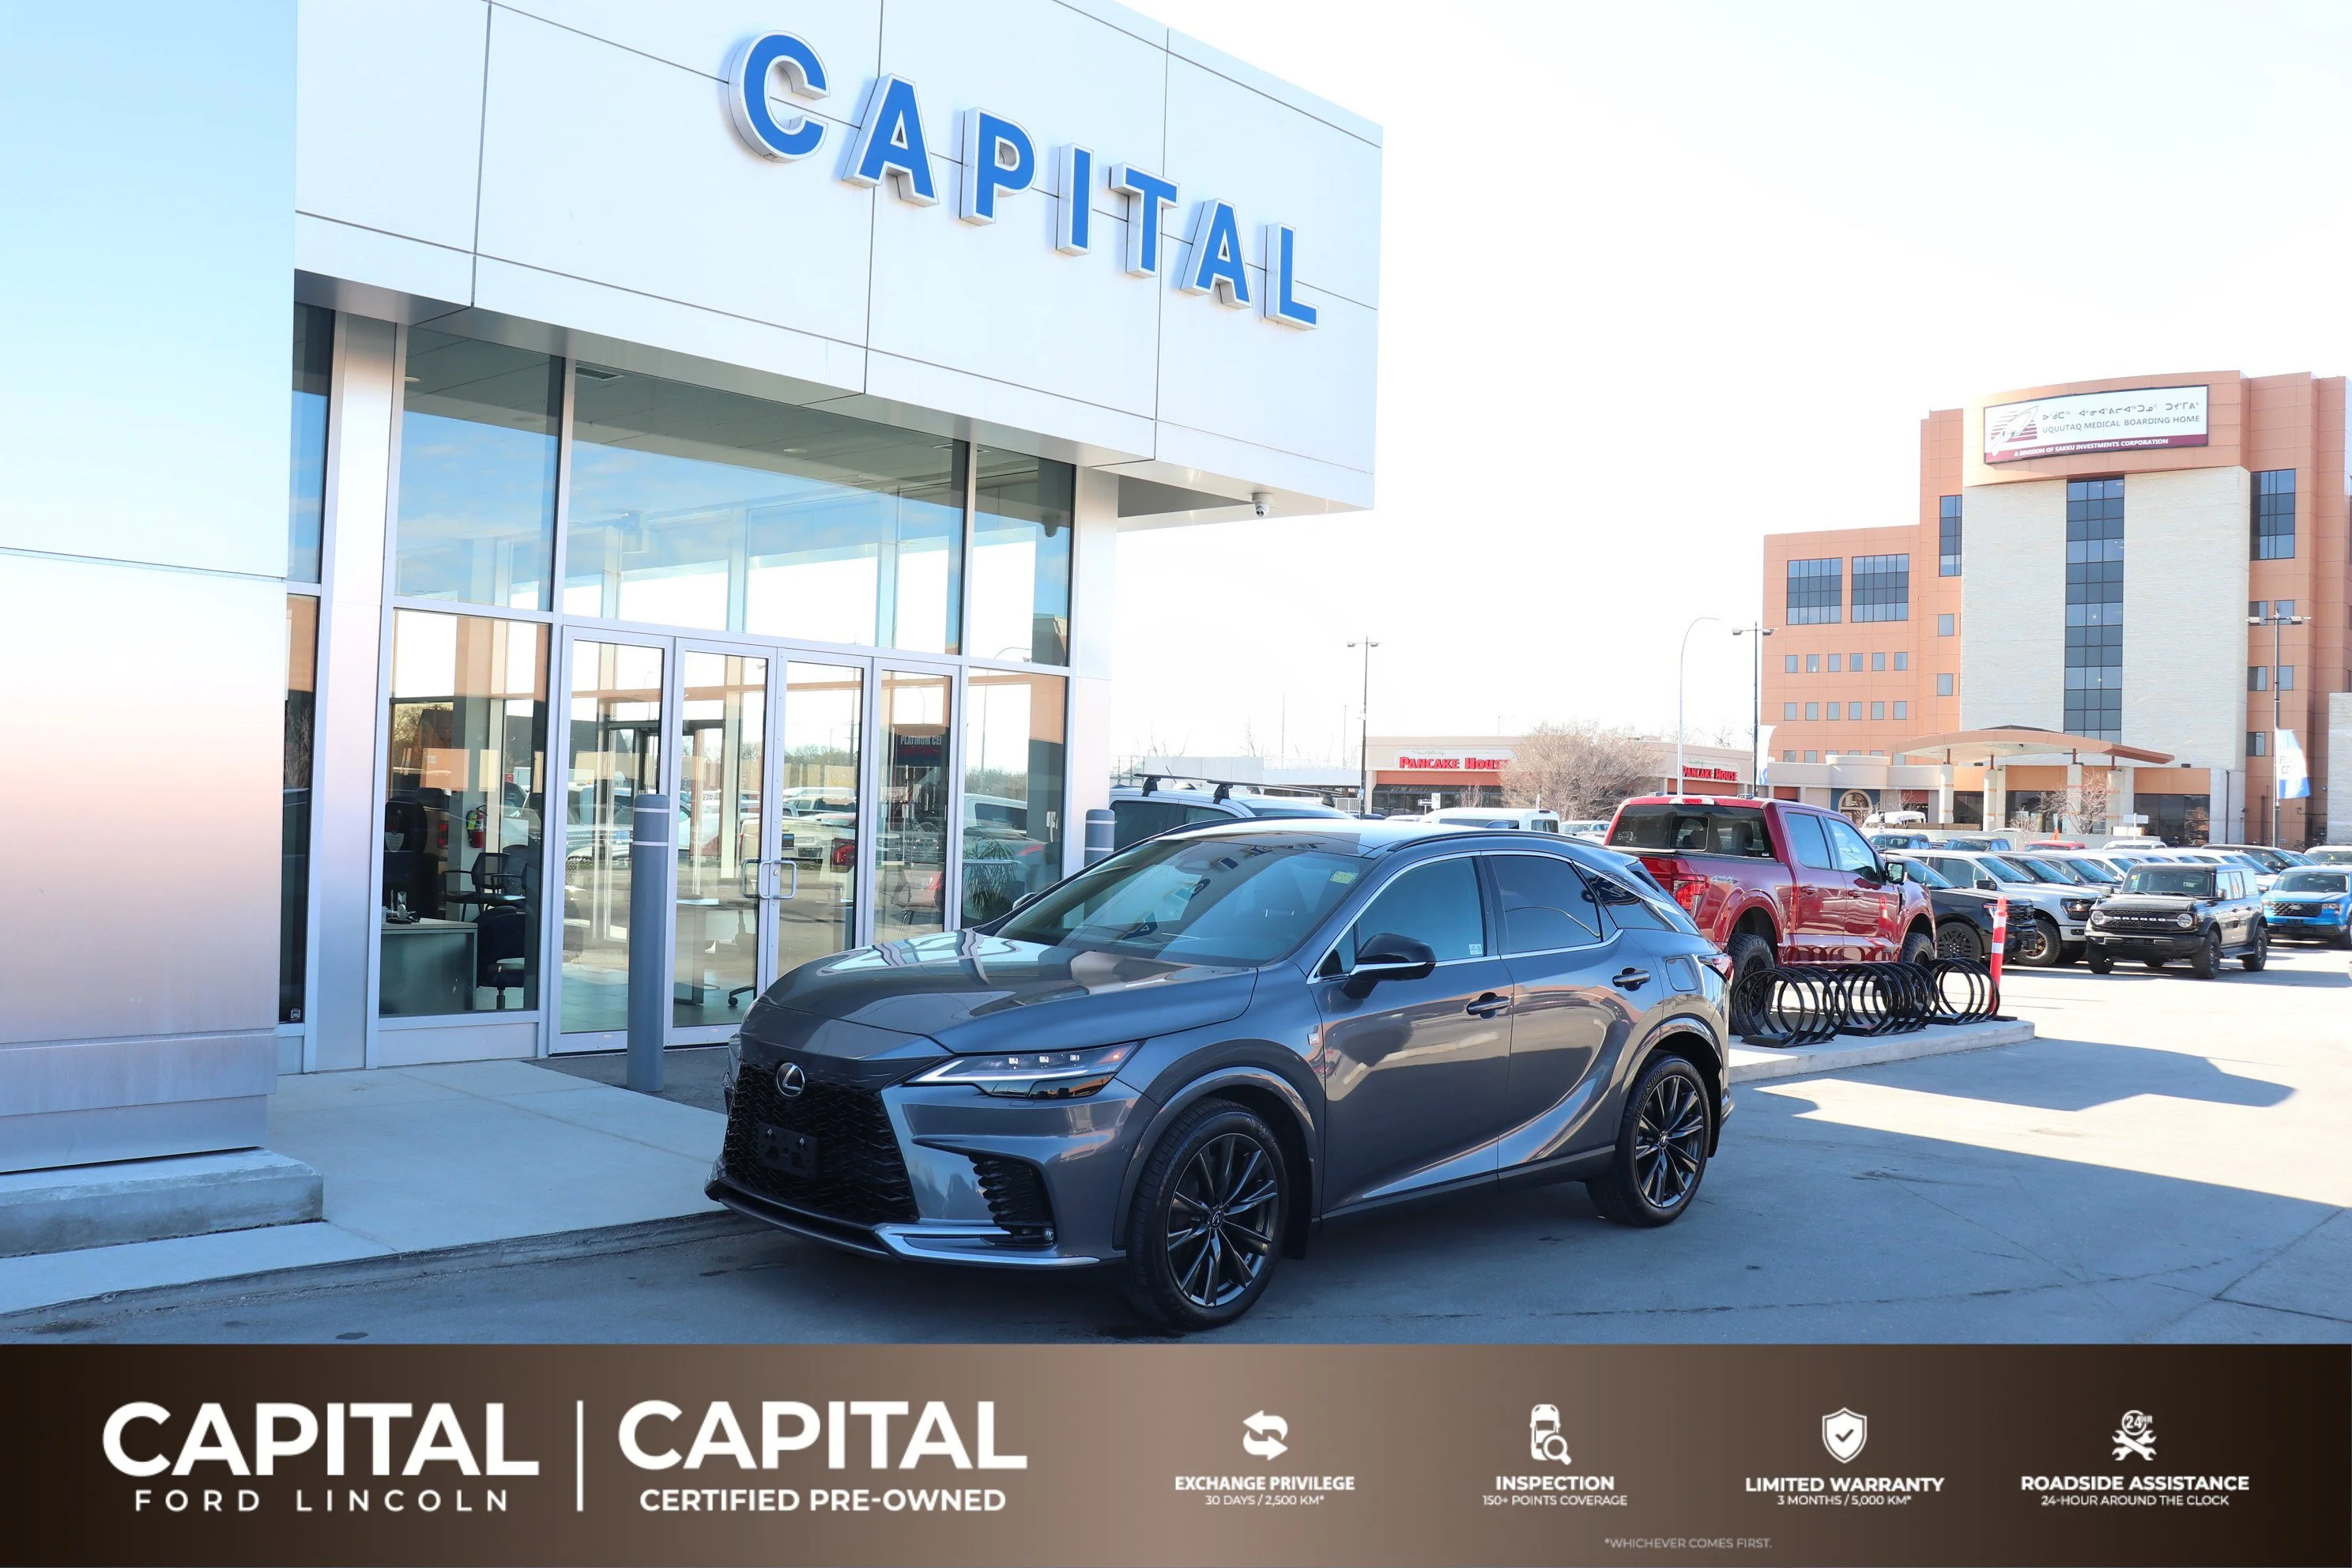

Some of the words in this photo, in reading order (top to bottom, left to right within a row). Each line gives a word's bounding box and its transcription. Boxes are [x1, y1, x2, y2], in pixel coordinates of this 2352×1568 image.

[729, 30, 1319, 330] CAPITAL
[2042, 424, 2082, 434] UQUUTAQ
[2084, 420, 2120, 429] MEDICAL
[2124, 416, 2170, 426] BOARDING
[2019, 448, 2045, 457] DIVISION
[2075, 441, 2120, 450] INVESTMENTS
[900, 735, 931, 745] PLATINUM
[1399, 756, 1460, 769] PANCAKE
[1683, 765, 1713, 779] PANCAKE
[1714, 768, 1738, 781] HOUSE
